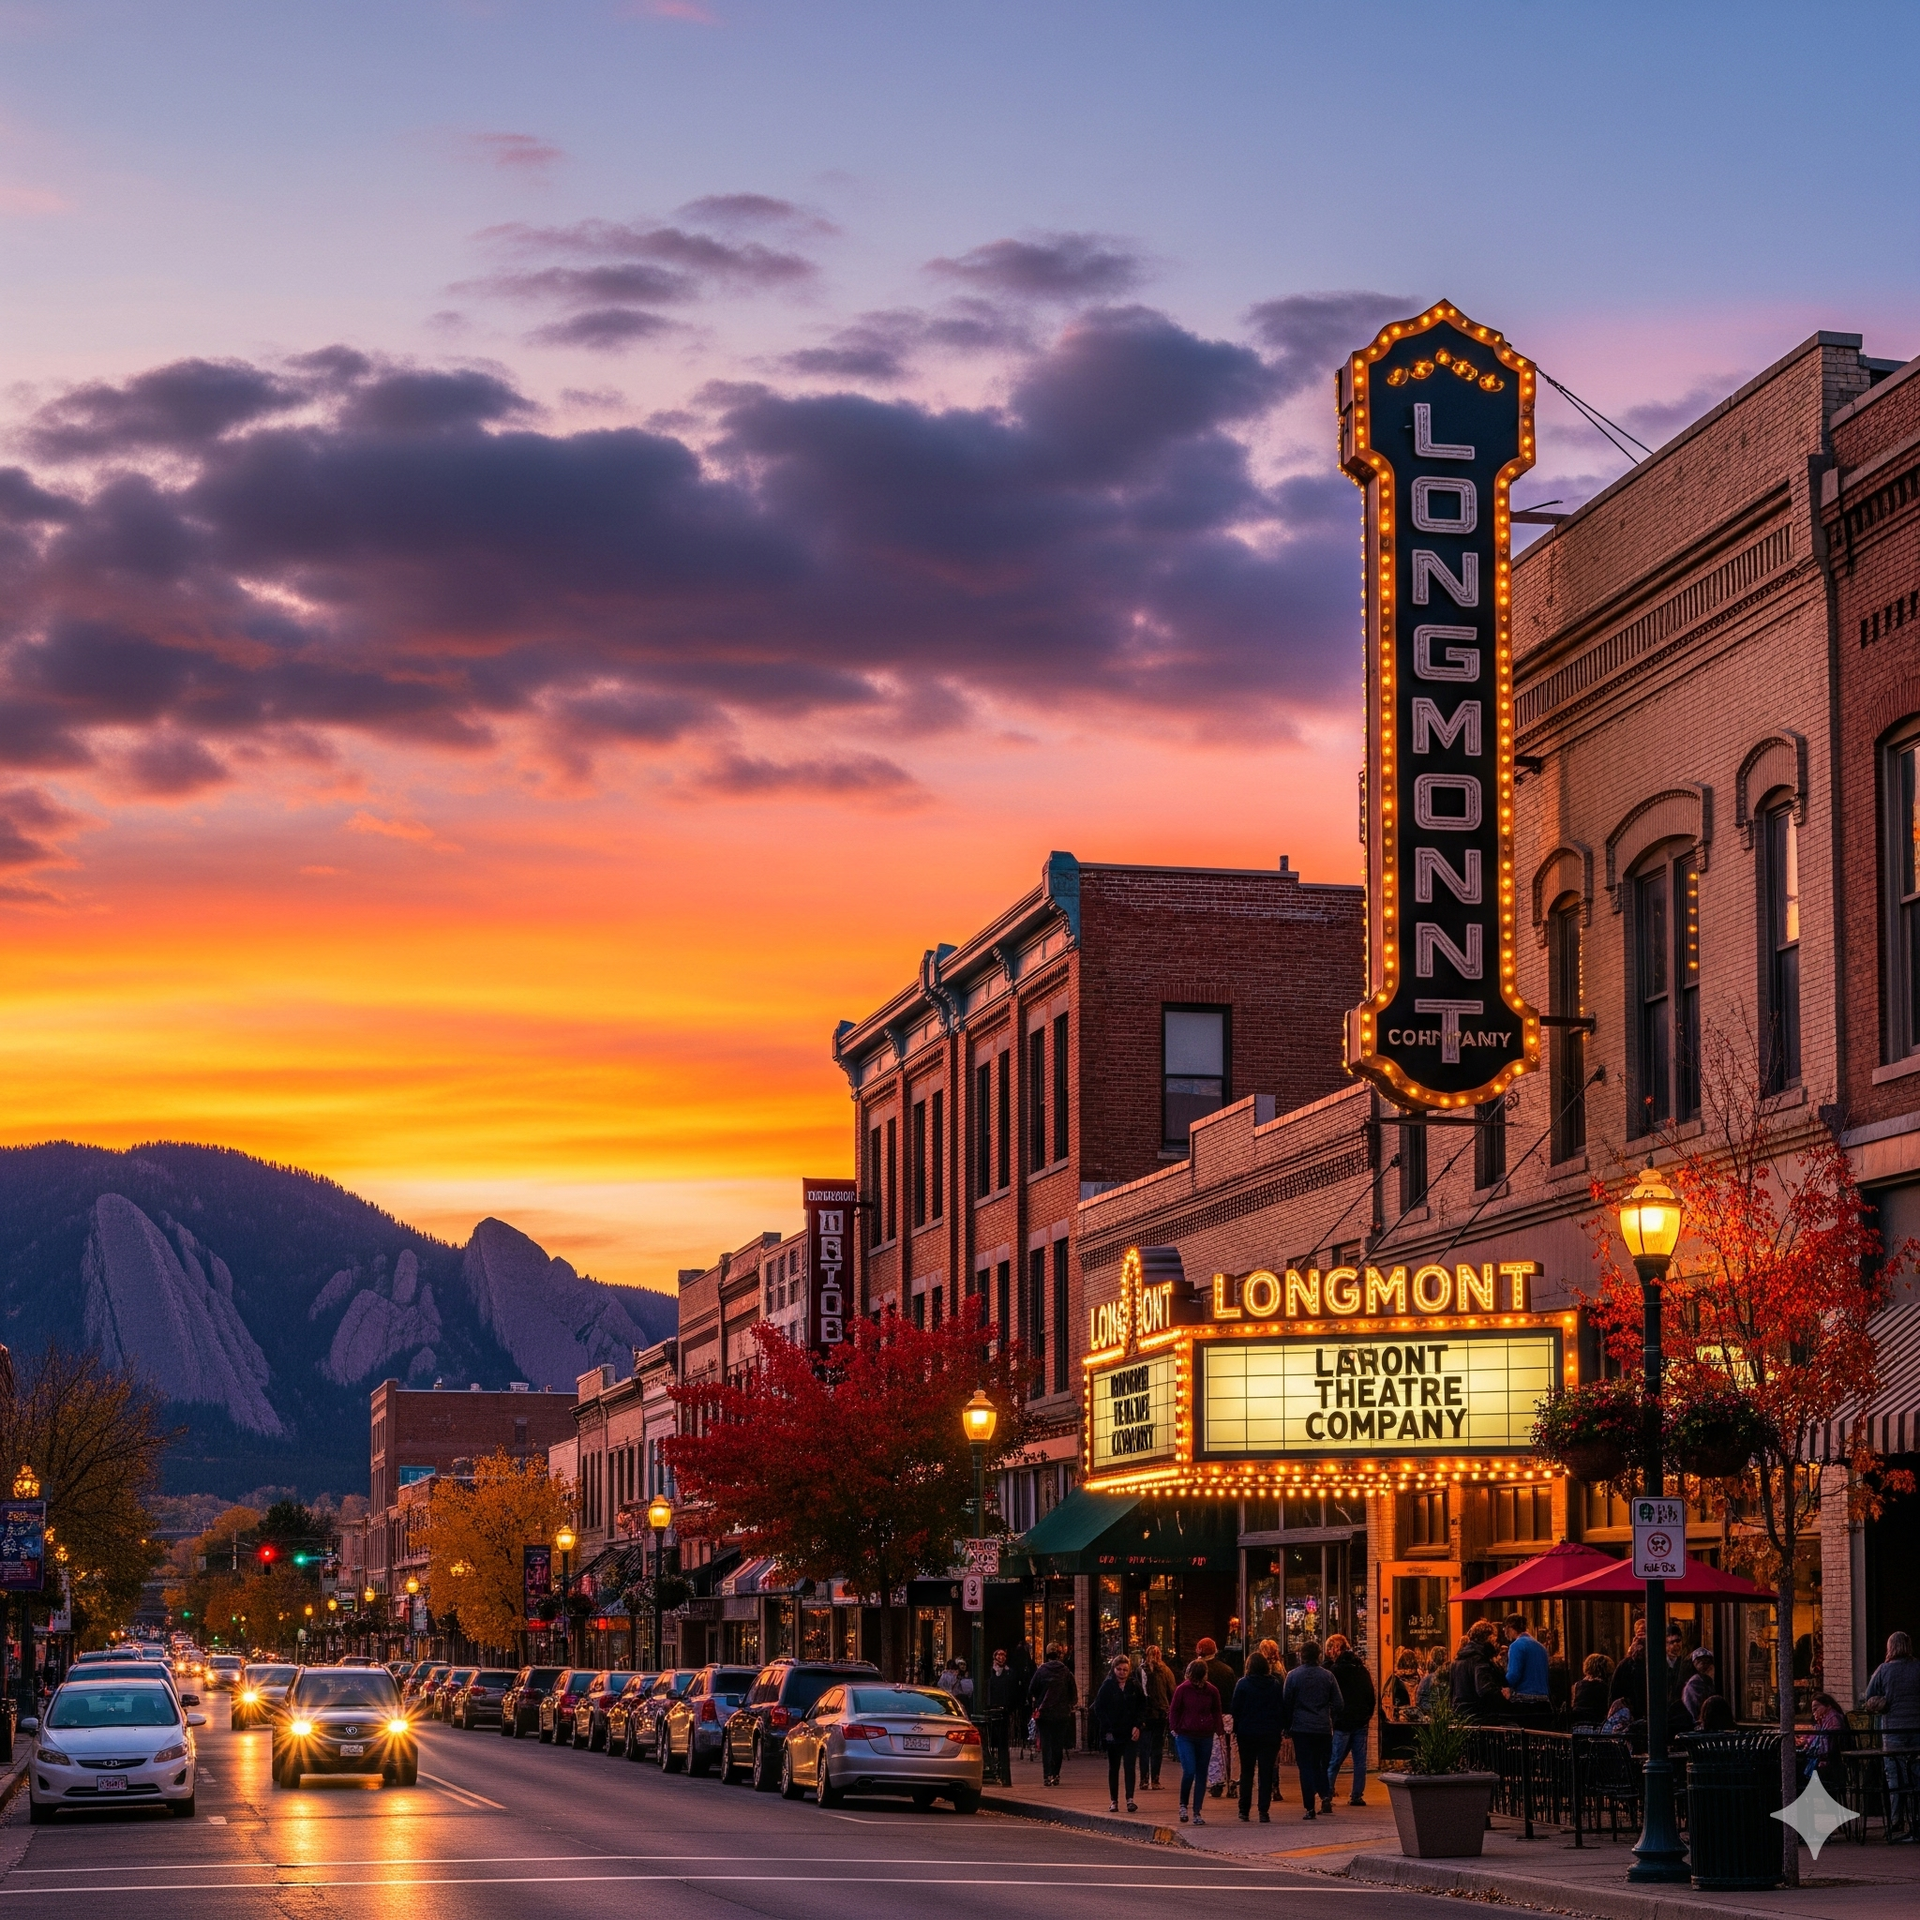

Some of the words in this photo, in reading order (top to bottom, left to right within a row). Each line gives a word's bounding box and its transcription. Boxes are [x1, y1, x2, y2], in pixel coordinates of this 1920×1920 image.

[1213, 1262, 1538, 1319] LONGMONT
[1090, 1281, 1172, 1351] LONGONT
[1314, 1376, 1463, 1409] THEATRE
[1305, 1408, 1468, 1440] COMPANY
